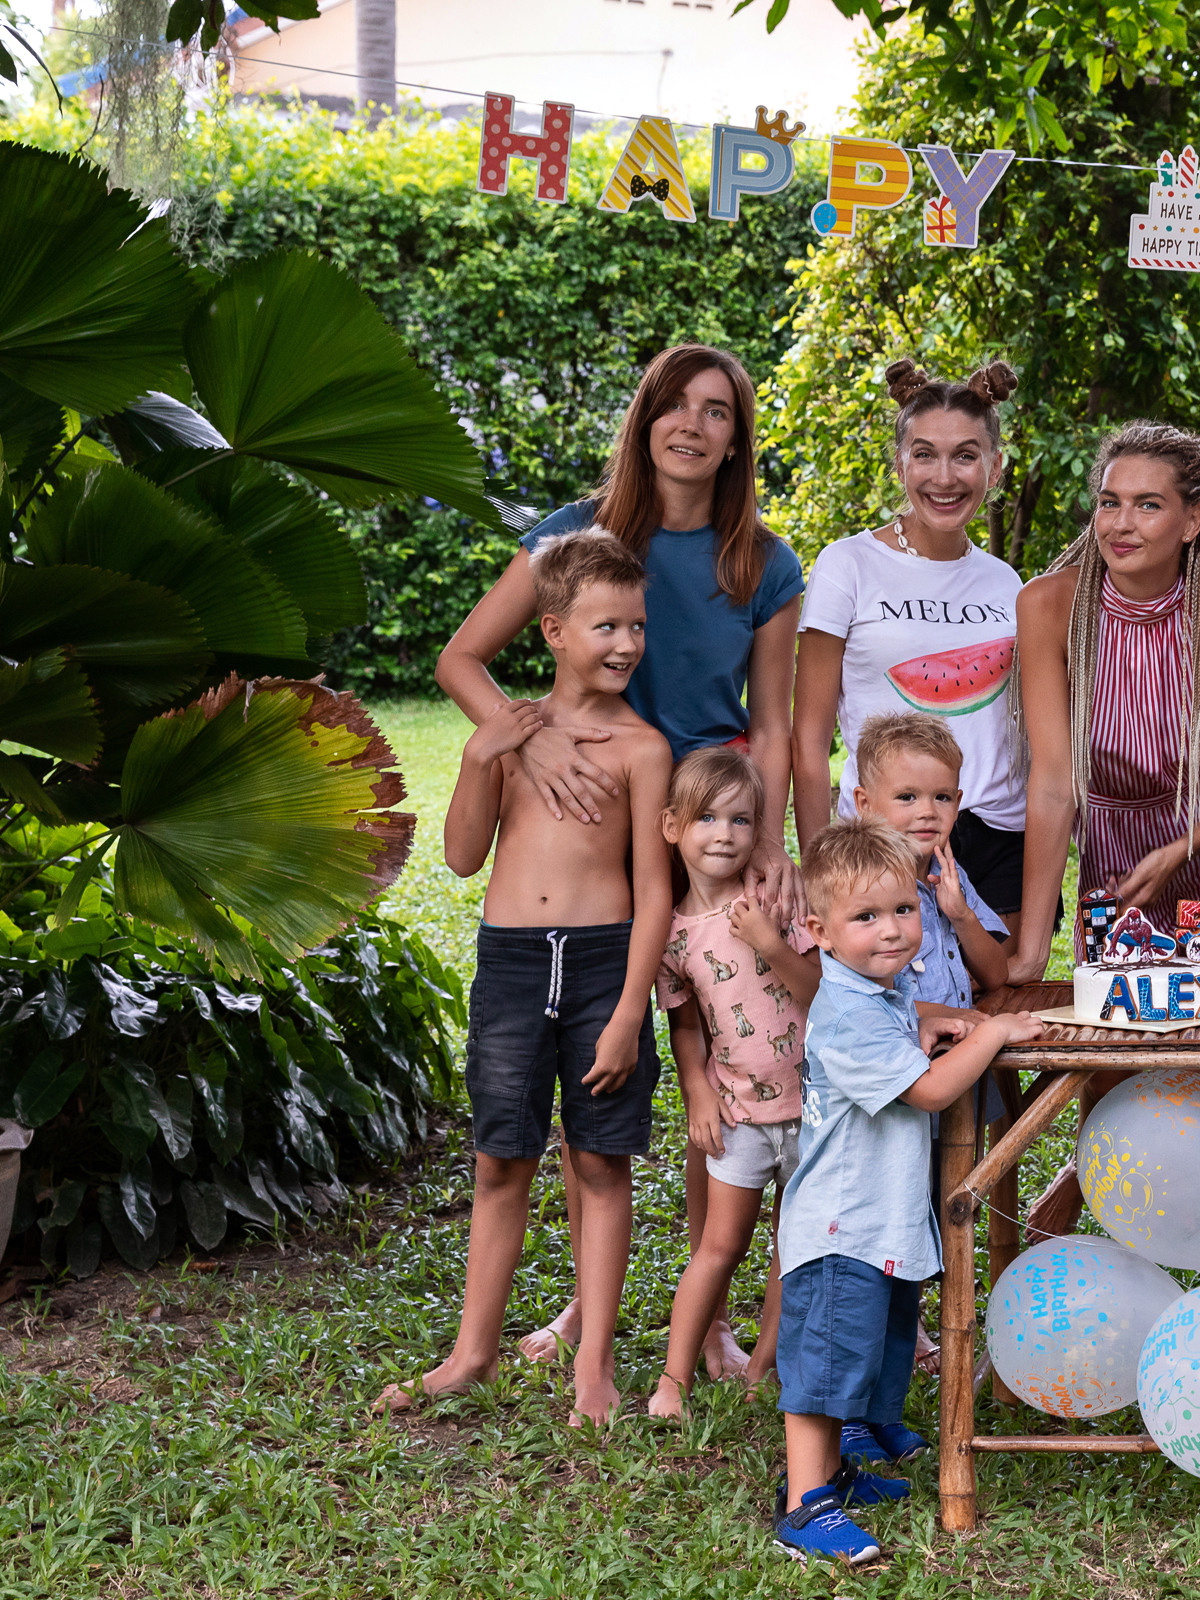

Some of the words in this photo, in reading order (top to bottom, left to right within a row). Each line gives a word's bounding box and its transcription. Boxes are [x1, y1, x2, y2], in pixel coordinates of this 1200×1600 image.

[476, 91, 1016, 248] HAPPY
[1160, 203, 1193, 220] HAVE
[1141, 237, 1182, 255] HAPPY
[1030, 1266, 1050, 1319] HAPPY
